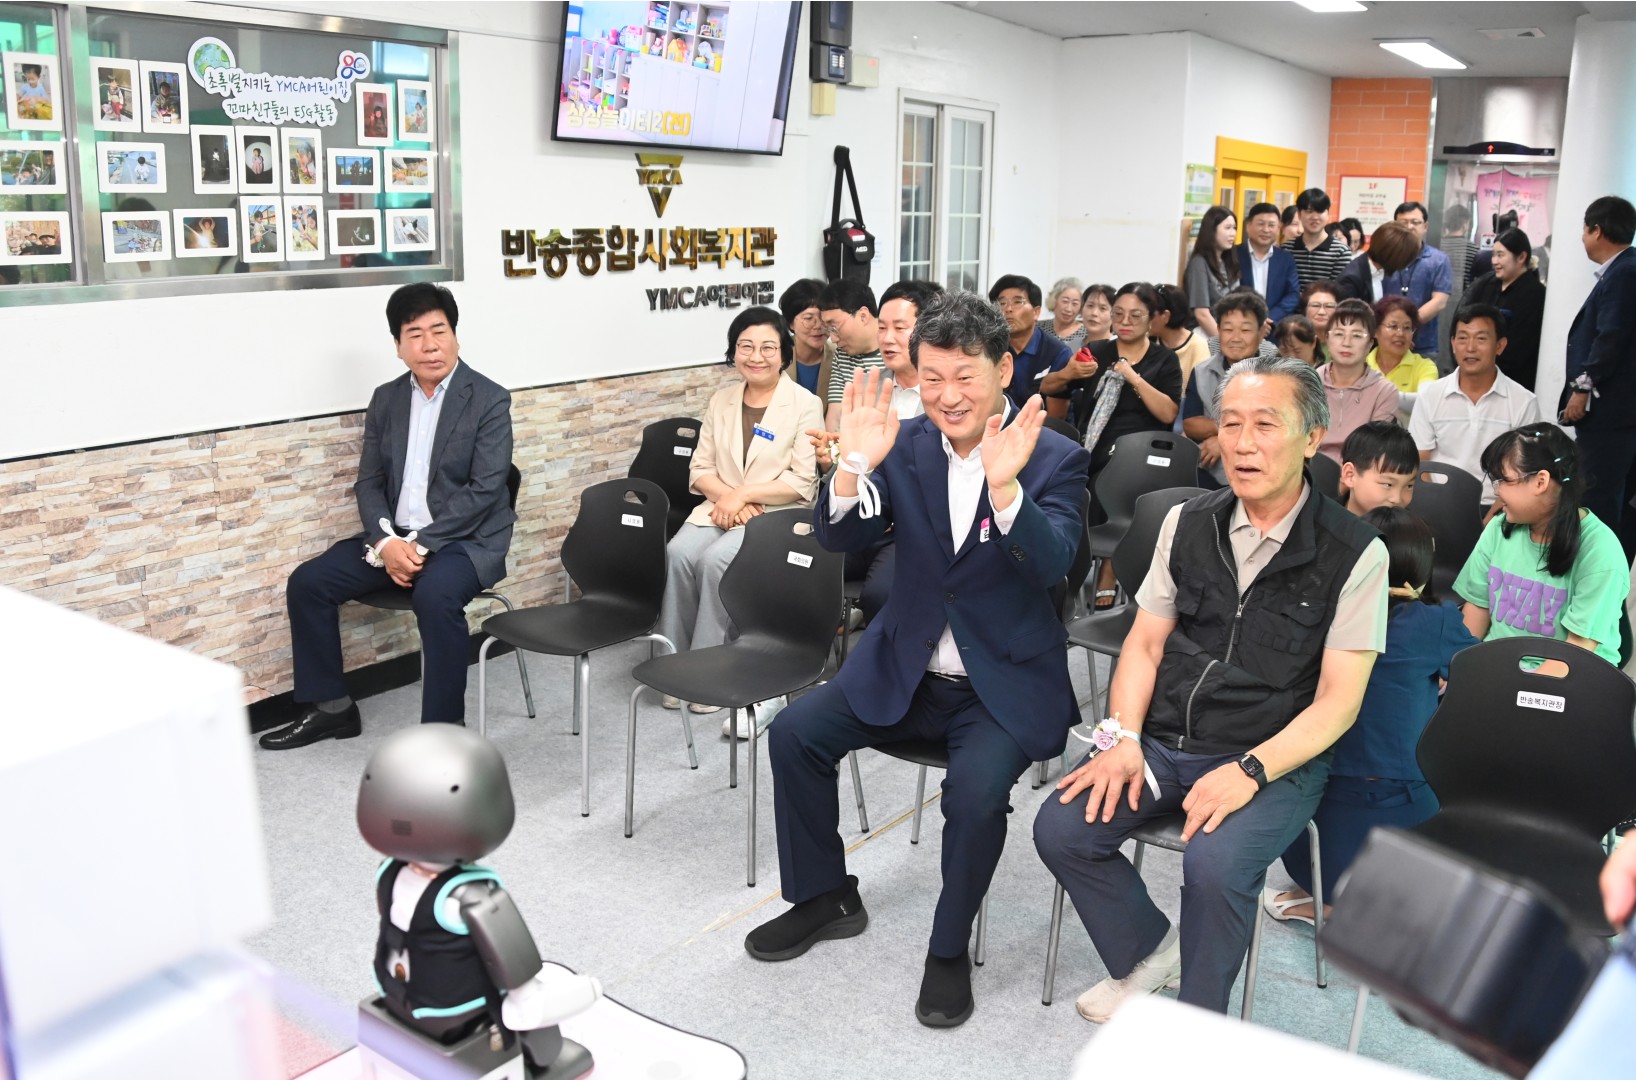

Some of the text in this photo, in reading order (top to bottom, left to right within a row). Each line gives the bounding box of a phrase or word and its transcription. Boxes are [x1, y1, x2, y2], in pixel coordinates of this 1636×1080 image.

[636, 169, 683, 185] YMCA
[501, 225, 777, 278] 반송종합사회복지관
[645, 281, 775, 311] YMCA어린이집
[1520, 696, 1563, 709] 반송복지관장
